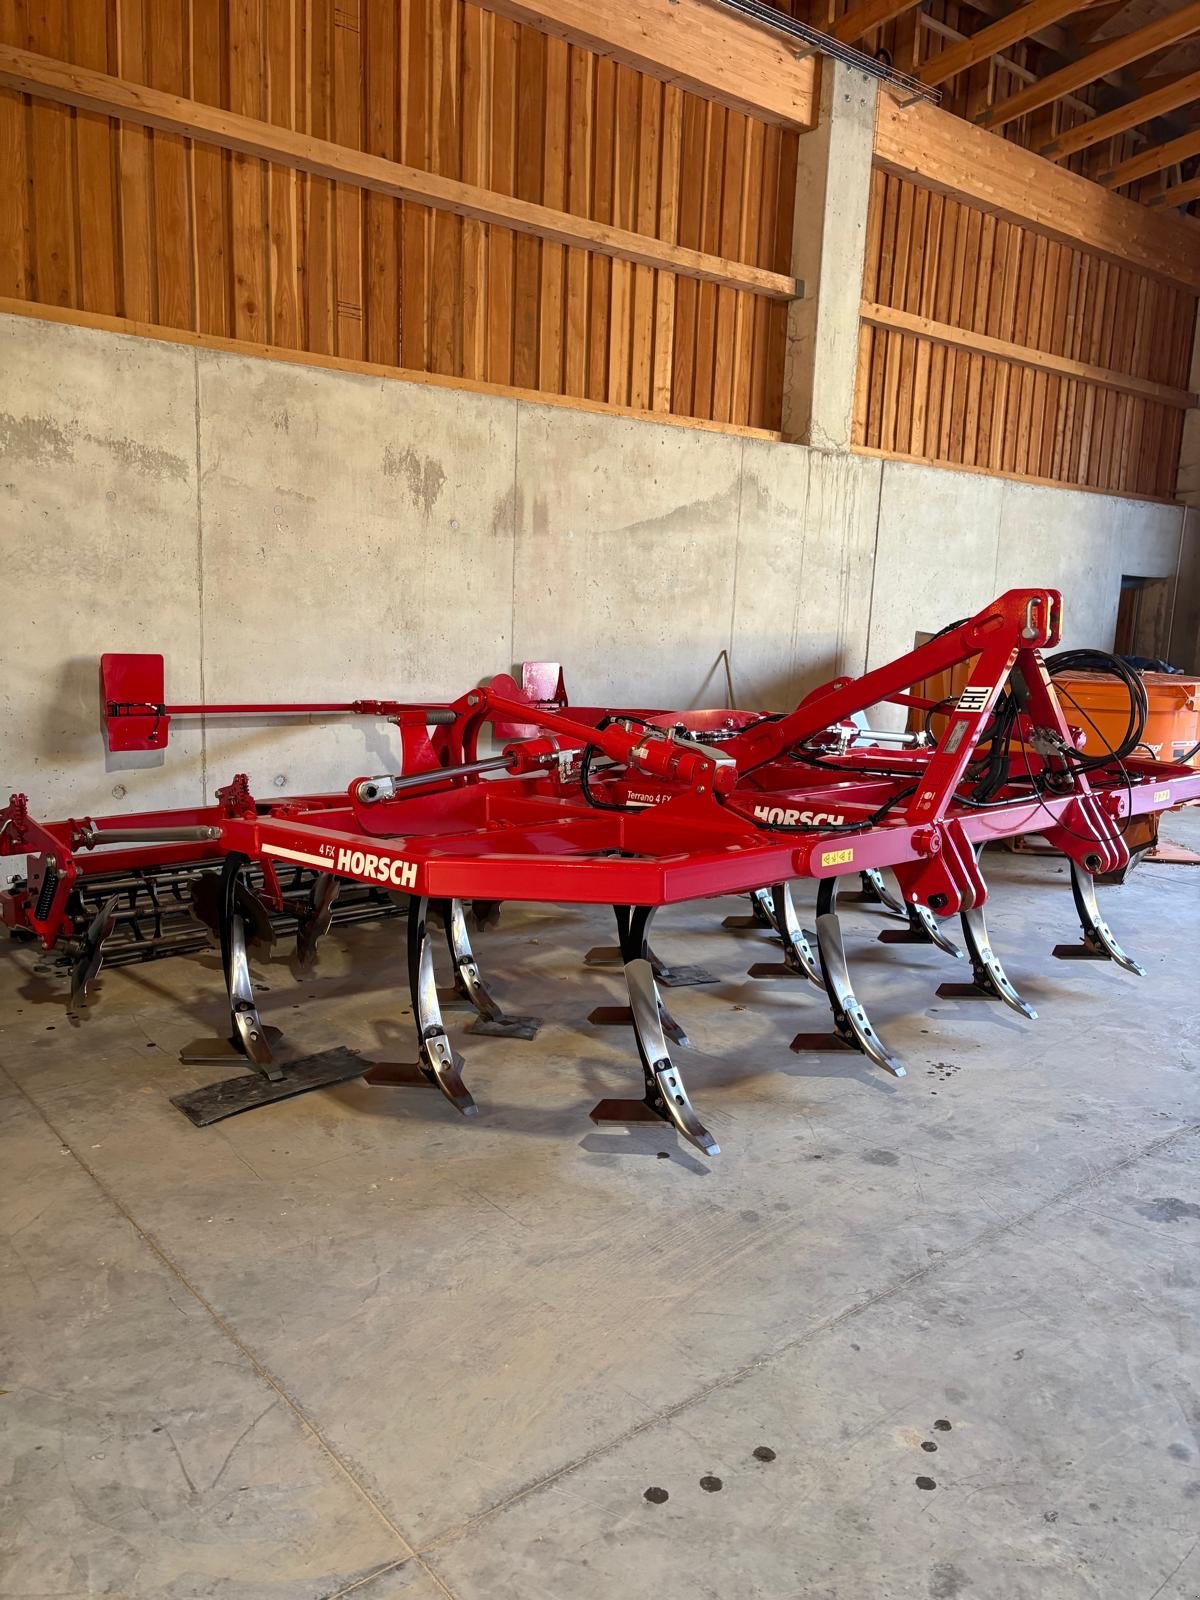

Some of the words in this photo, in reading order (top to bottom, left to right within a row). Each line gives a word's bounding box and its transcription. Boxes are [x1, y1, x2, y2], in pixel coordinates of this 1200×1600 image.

[627, 790, 654, 802] Terrano
[655, 794, 661, 803] 4
[753, 805, 844, 826] HORSCH
[319, 844, 325, 855] 4
[325, 844, 336, 857] FX
[337, 847, 418, 888] HORSCH
